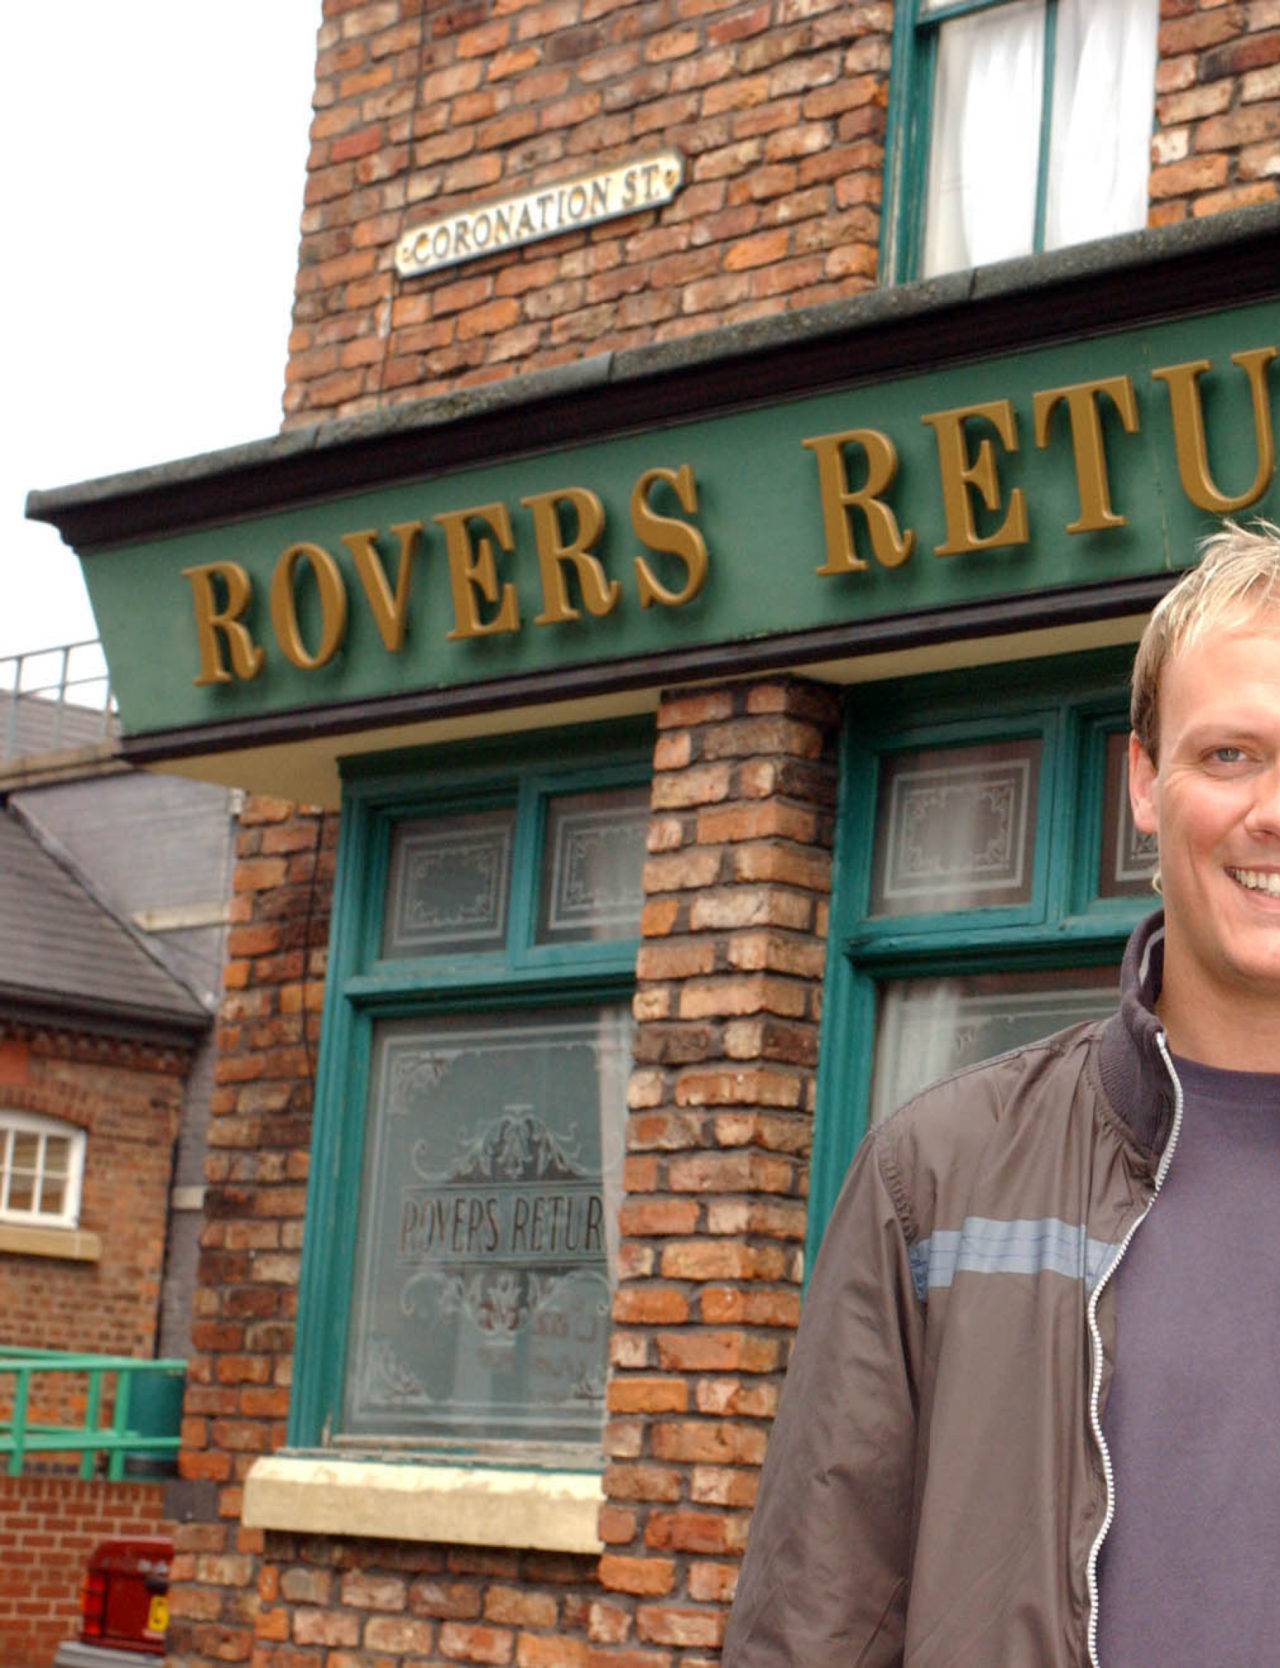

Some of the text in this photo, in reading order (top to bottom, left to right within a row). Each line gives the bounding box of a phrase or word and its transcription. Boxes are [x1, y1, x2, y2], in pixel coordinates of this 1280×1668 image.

[411, 176, 611, 265] CORONATION
[182, 463, 708, 687] ROVERS
[511, 1194, 605, 1252] RETUR
